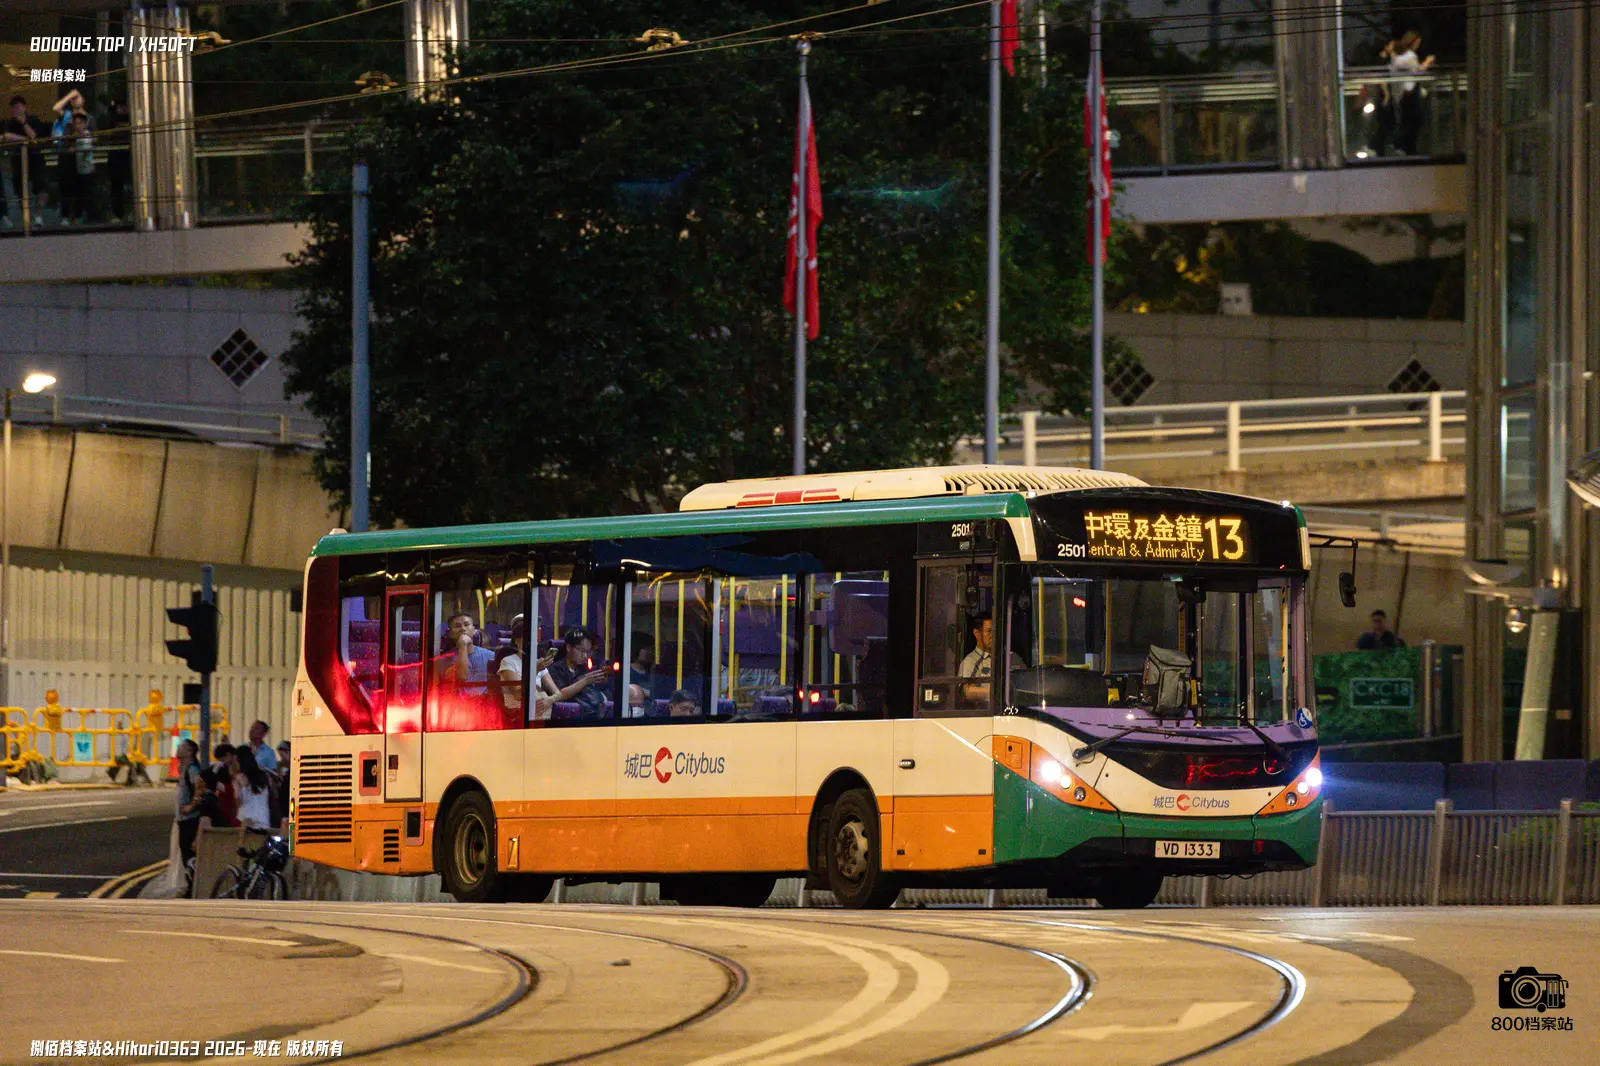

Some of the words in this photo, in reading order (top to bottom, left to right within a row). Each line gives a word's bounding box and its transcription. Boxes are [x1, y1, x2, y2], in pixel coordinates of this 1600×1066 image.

[951, 523, 970, 538] 2501
[1084, 511, 1204, 543] 中環及金鐘
[1204, 518, 1244, 560] 13
[1057, 543, 1086, 558] 2501
[1088, 540, 1126, 557] entral
[1129, 543, 1142, 558] &
[1145, 541, 1205, 562] Admiralty
[624, 753, 653, 779] 城巴
[674, 751, 726, 777] Citybus
[1153, 796, 1175, 809] 城巴
[1192, 796, 1230, 809] Citybus
[1163, 842, 1180, 856] VD
[1184, 842, 1214, 857] 1333
